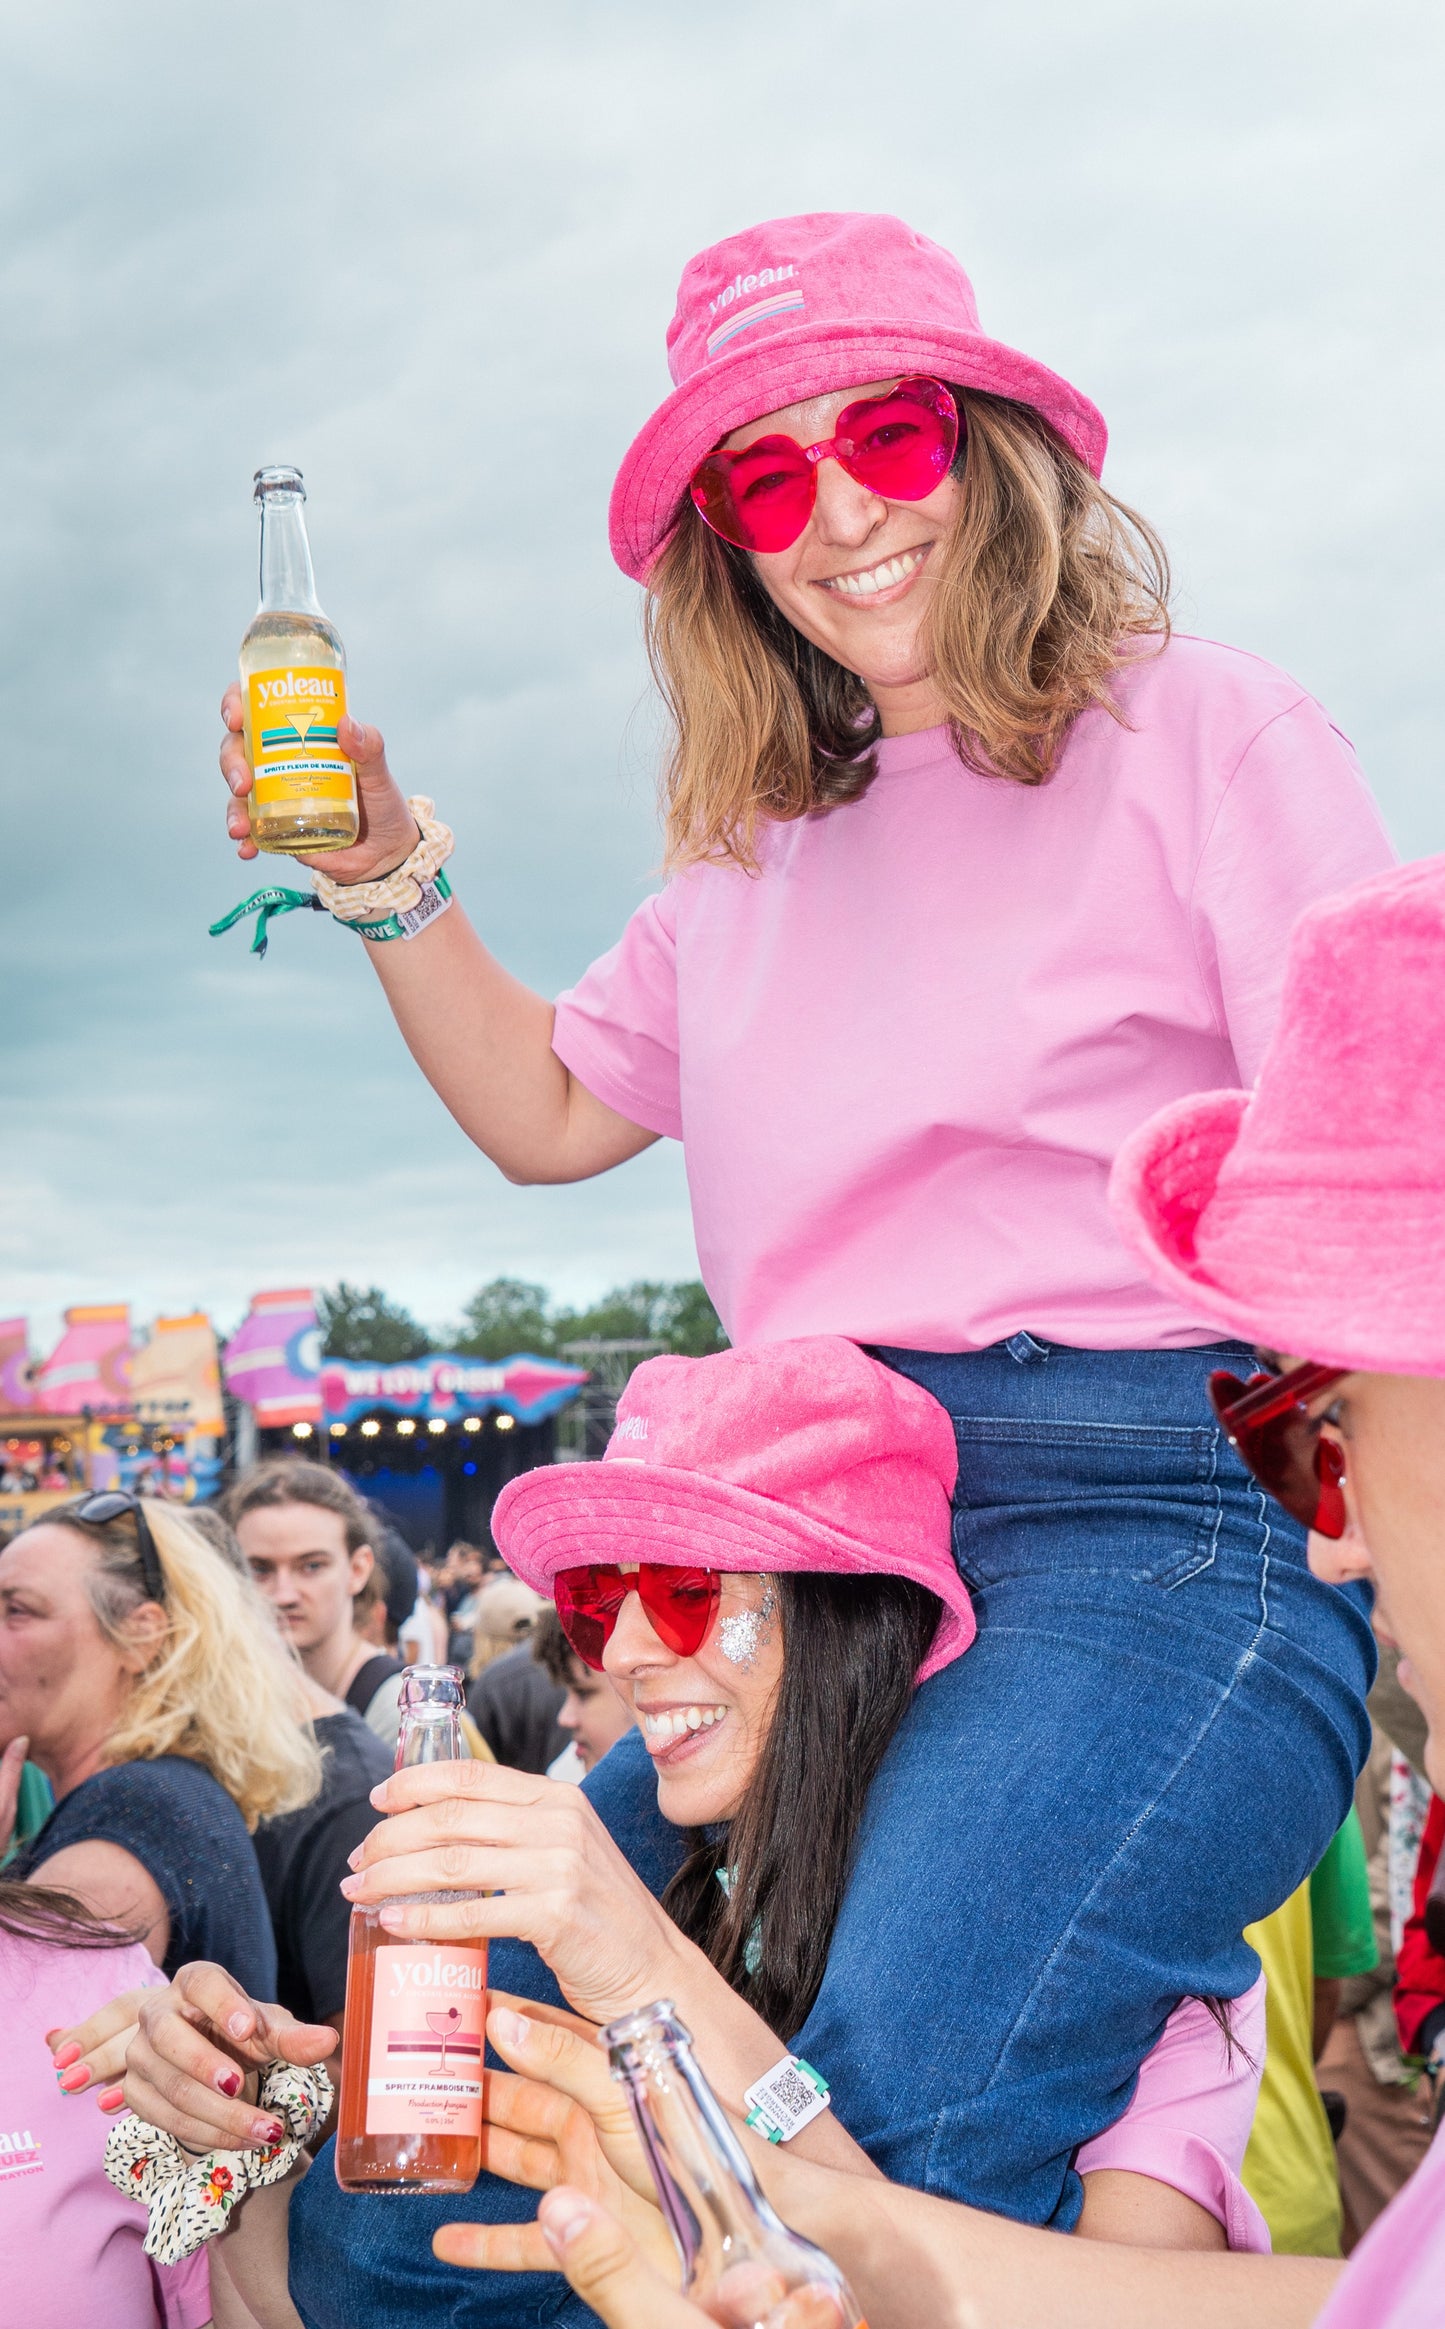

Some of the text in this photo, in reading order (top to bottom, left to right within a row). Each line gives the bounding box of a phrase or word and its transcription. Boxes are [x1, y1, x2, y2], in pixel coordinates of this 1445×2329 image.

[258, 671, 338, 708] yoleau.
[264, 765, 286, 774] SPRITZ
[356, 924, 396, 939] LOVE
[389, 1953, 483, 1997] yoleau.
[385, 2083, 416, 2091] SPRITZ
[419, 2084, 464, 2092] FRAMBOISE
[408, 2099, 443, 2108] Production
[0, 2151, 40, 2166] UEZ
[0, 2166, 44, 2181] RATION
